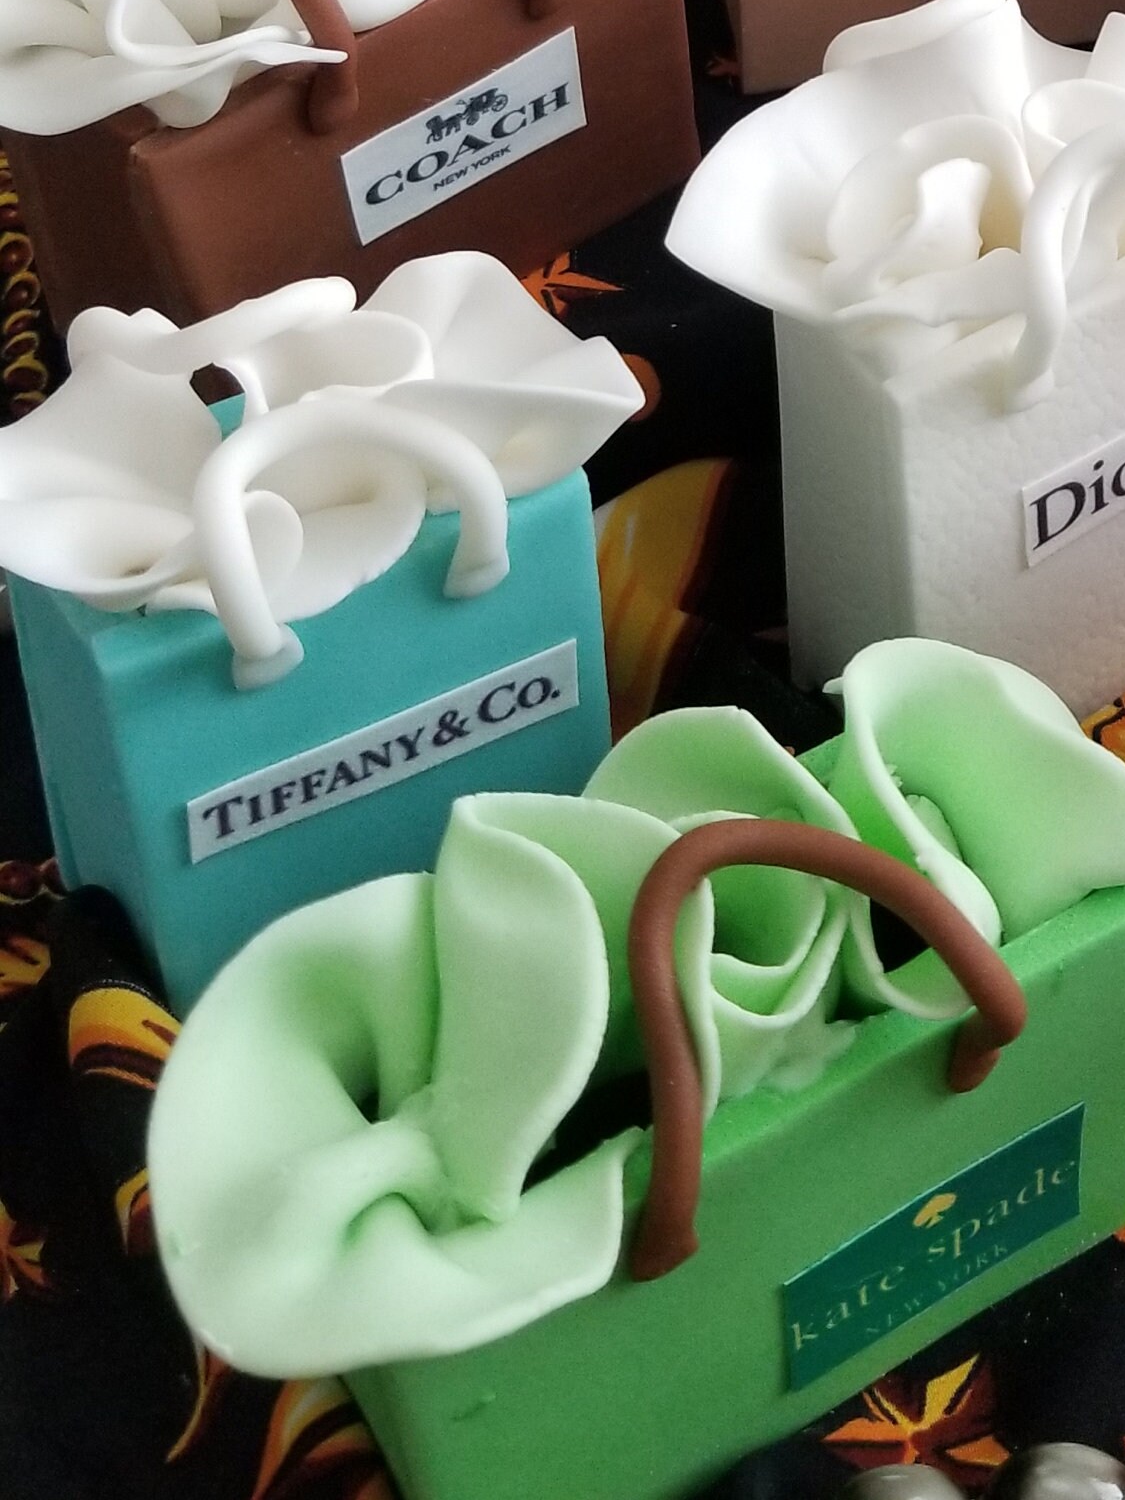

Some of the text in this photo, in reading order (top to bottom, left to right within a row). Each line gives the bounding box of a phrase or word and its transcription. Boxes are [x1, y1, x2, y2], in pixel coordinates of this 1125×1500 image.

[364, 81, 571, 206] COACH
[432, 143, 512, 192] NEW YORK
[790, 1160, 1077, 1351] kate spade
